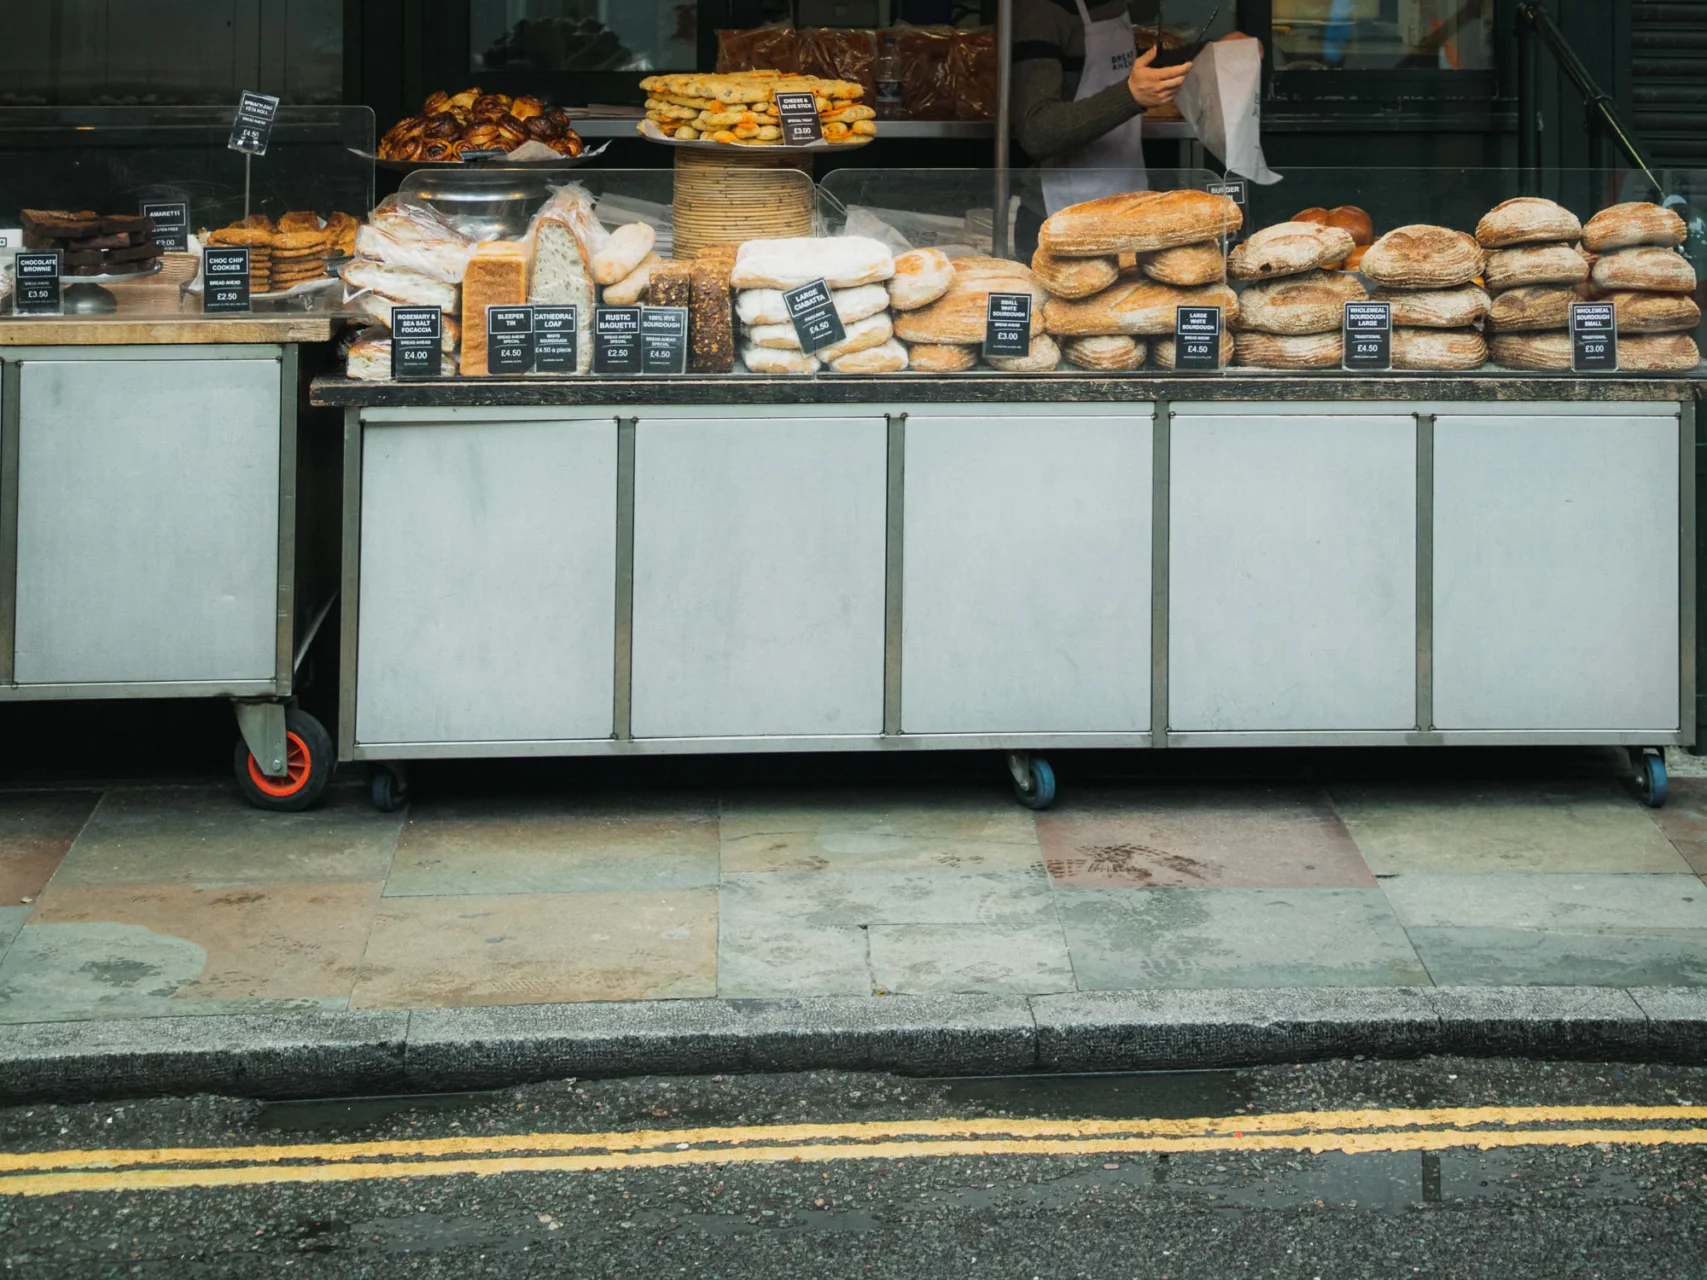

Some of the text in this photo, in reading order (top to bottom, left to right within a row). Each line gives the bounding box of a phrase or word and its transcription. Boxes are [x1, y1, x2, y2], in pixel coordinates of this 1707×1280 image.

[795, 288, 818, 302] LARGE
[794, 294, 825, 311] CIABATTA
[810, 321, 829, 334] £4.50
[405, 351, 427, 359] £4.00
